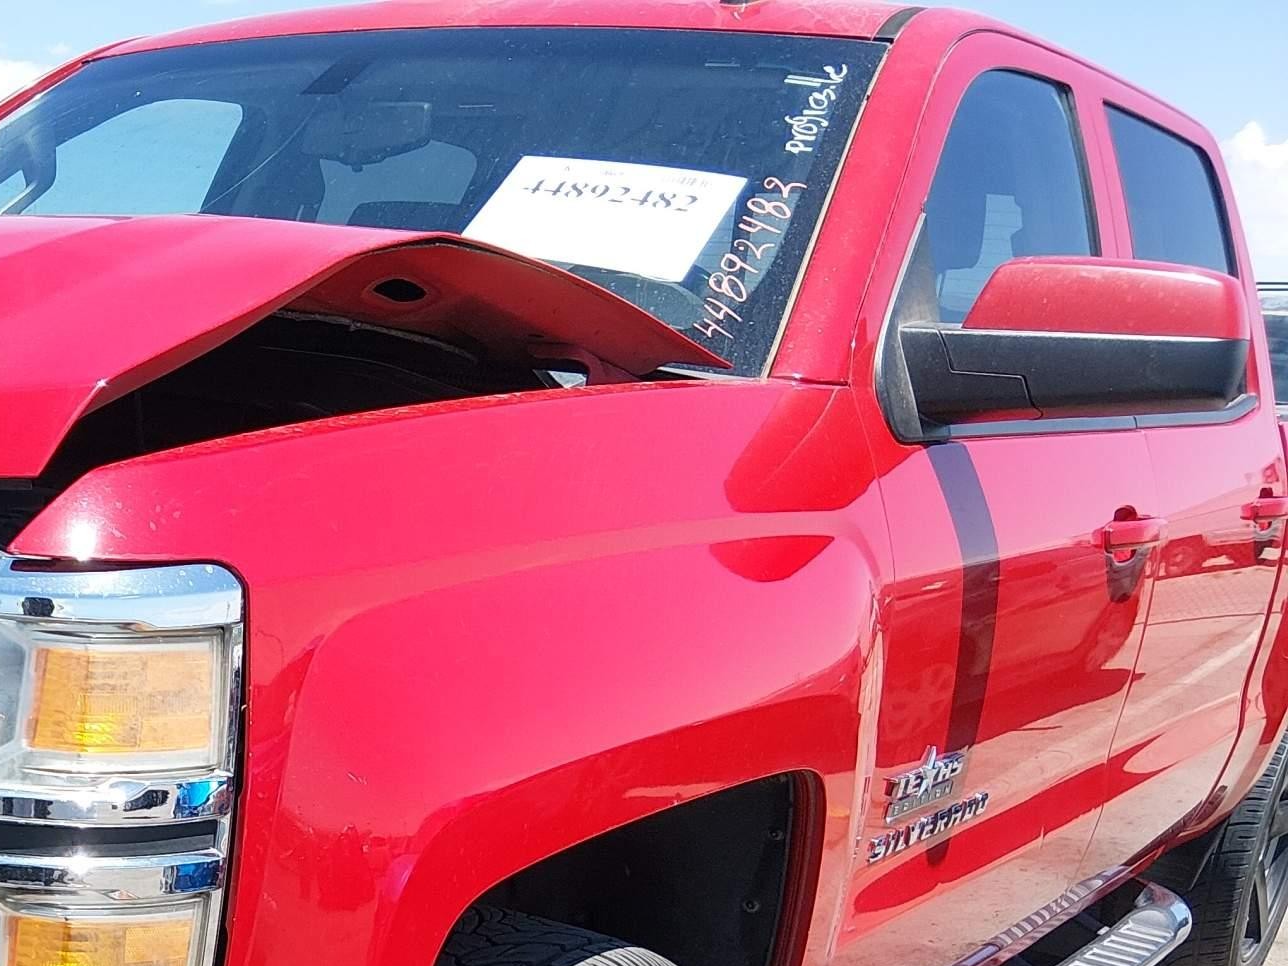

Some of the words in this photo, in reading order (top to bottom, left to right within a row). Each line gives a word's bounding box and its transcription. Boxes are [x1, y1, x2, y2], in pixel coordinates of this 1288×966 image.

[522, 178, 698, 212] 44892482
[693, 177, 808, 339] 44892482
[868, 791, 989, 863] SILVERADO
